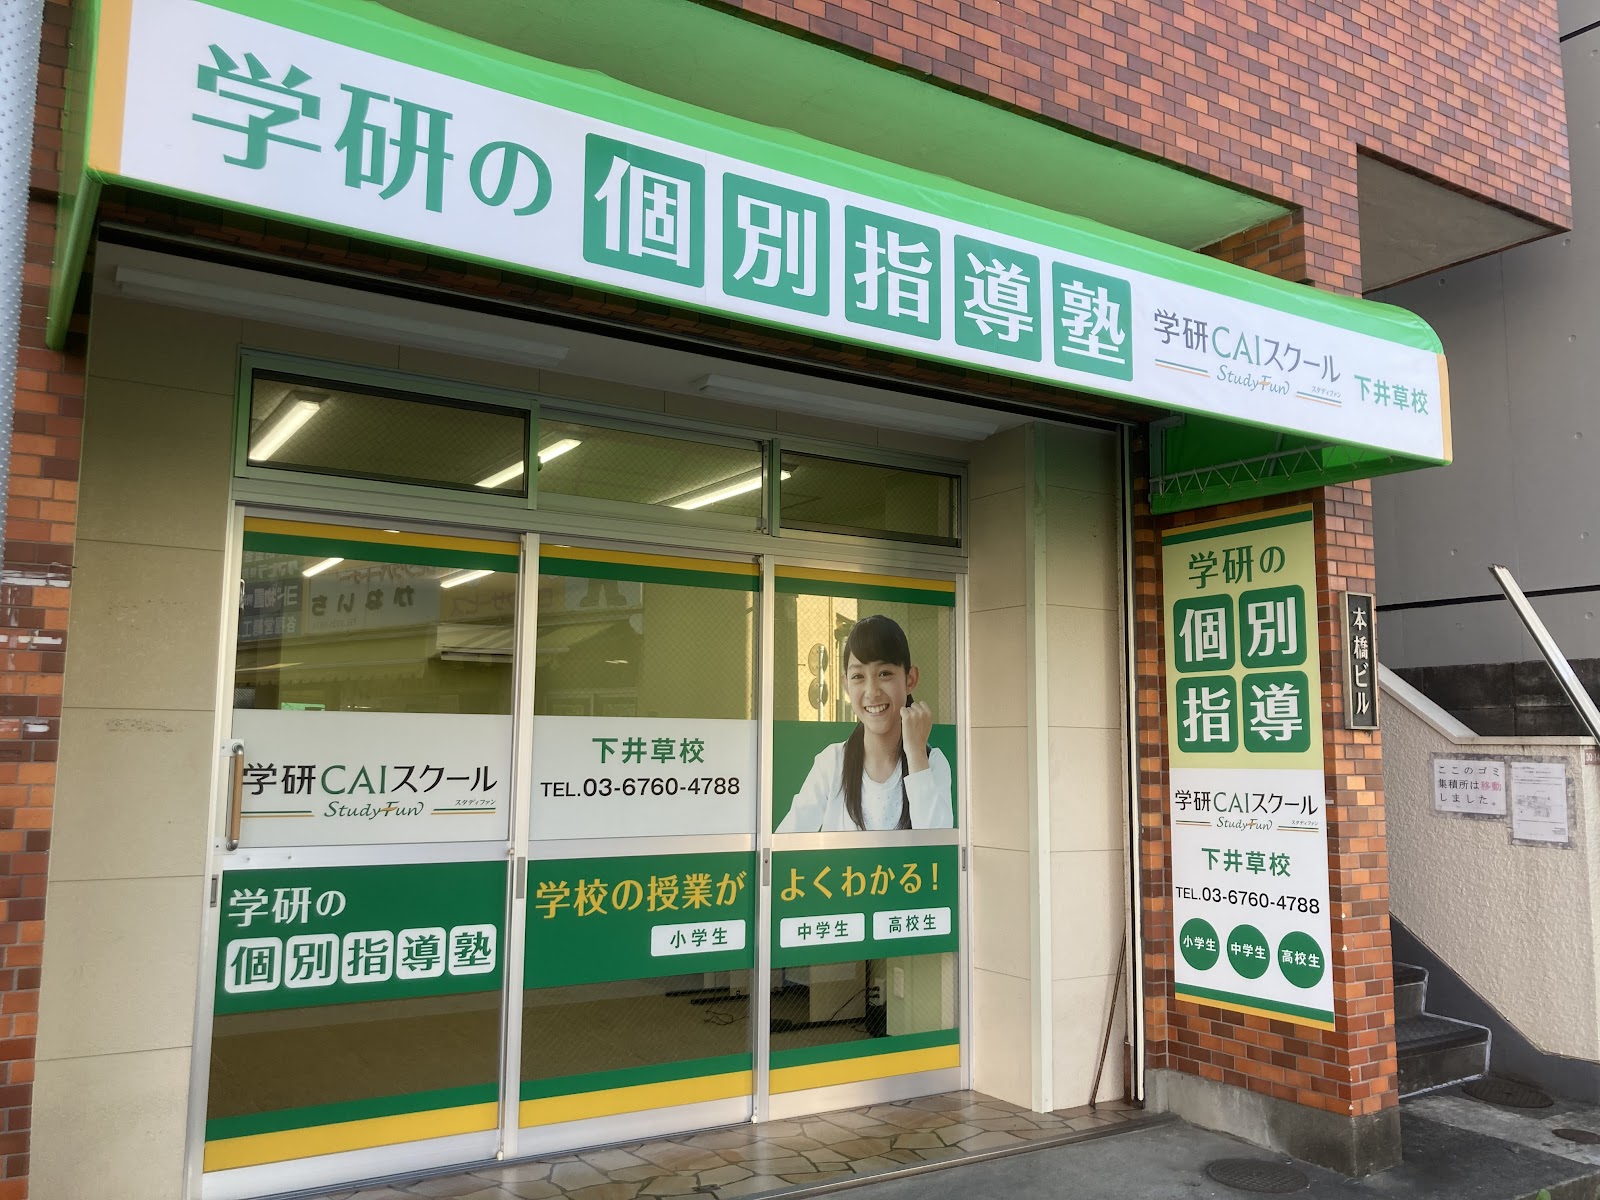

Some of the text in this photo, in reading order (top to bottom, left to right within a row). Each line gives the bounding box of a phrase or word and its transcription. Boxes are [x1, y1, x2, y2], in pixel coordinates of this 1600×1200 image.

[1153, 308, 1341, 383] 学研CAIスクール
[1354, 374, 1429, 415] 下井草校
[1188, 545, 1286, 589] 学研の
[1179, 596, 1298, 663] 個別
[1352, 606, 1370, 715] 本橋ビル
[1182, 682, 1303, 742] 指導
[592, 737, 705, 764] 下井草校
[242, 762, 497, 796] 学研CAIスクール
[540, 777, 740, 797] TEL.03-6760-4788
[1438, 765, 1500, 777] ここのゴミ
[1438, 778, 1502, 791] 集積所は移動
[1175, 790, 1319, 815] 学研CAIスクール
[1440, 792, 1497, 806] しました。
[1201, 847, 1291, 877] 下井草校
[228, 886, 347, 928] 学研の
[535, 862, 939, 919] 学校の授業が よくわかる！
[1175, 886, 1320, 914] TEL.03-6760-4788
[670, 913, 938, 949] 小学生 中学生 高校生
[230, 931, 492, 986] 個別指導塾
[1183, 935, 1321, 969] 小学生 中学生 高校生
